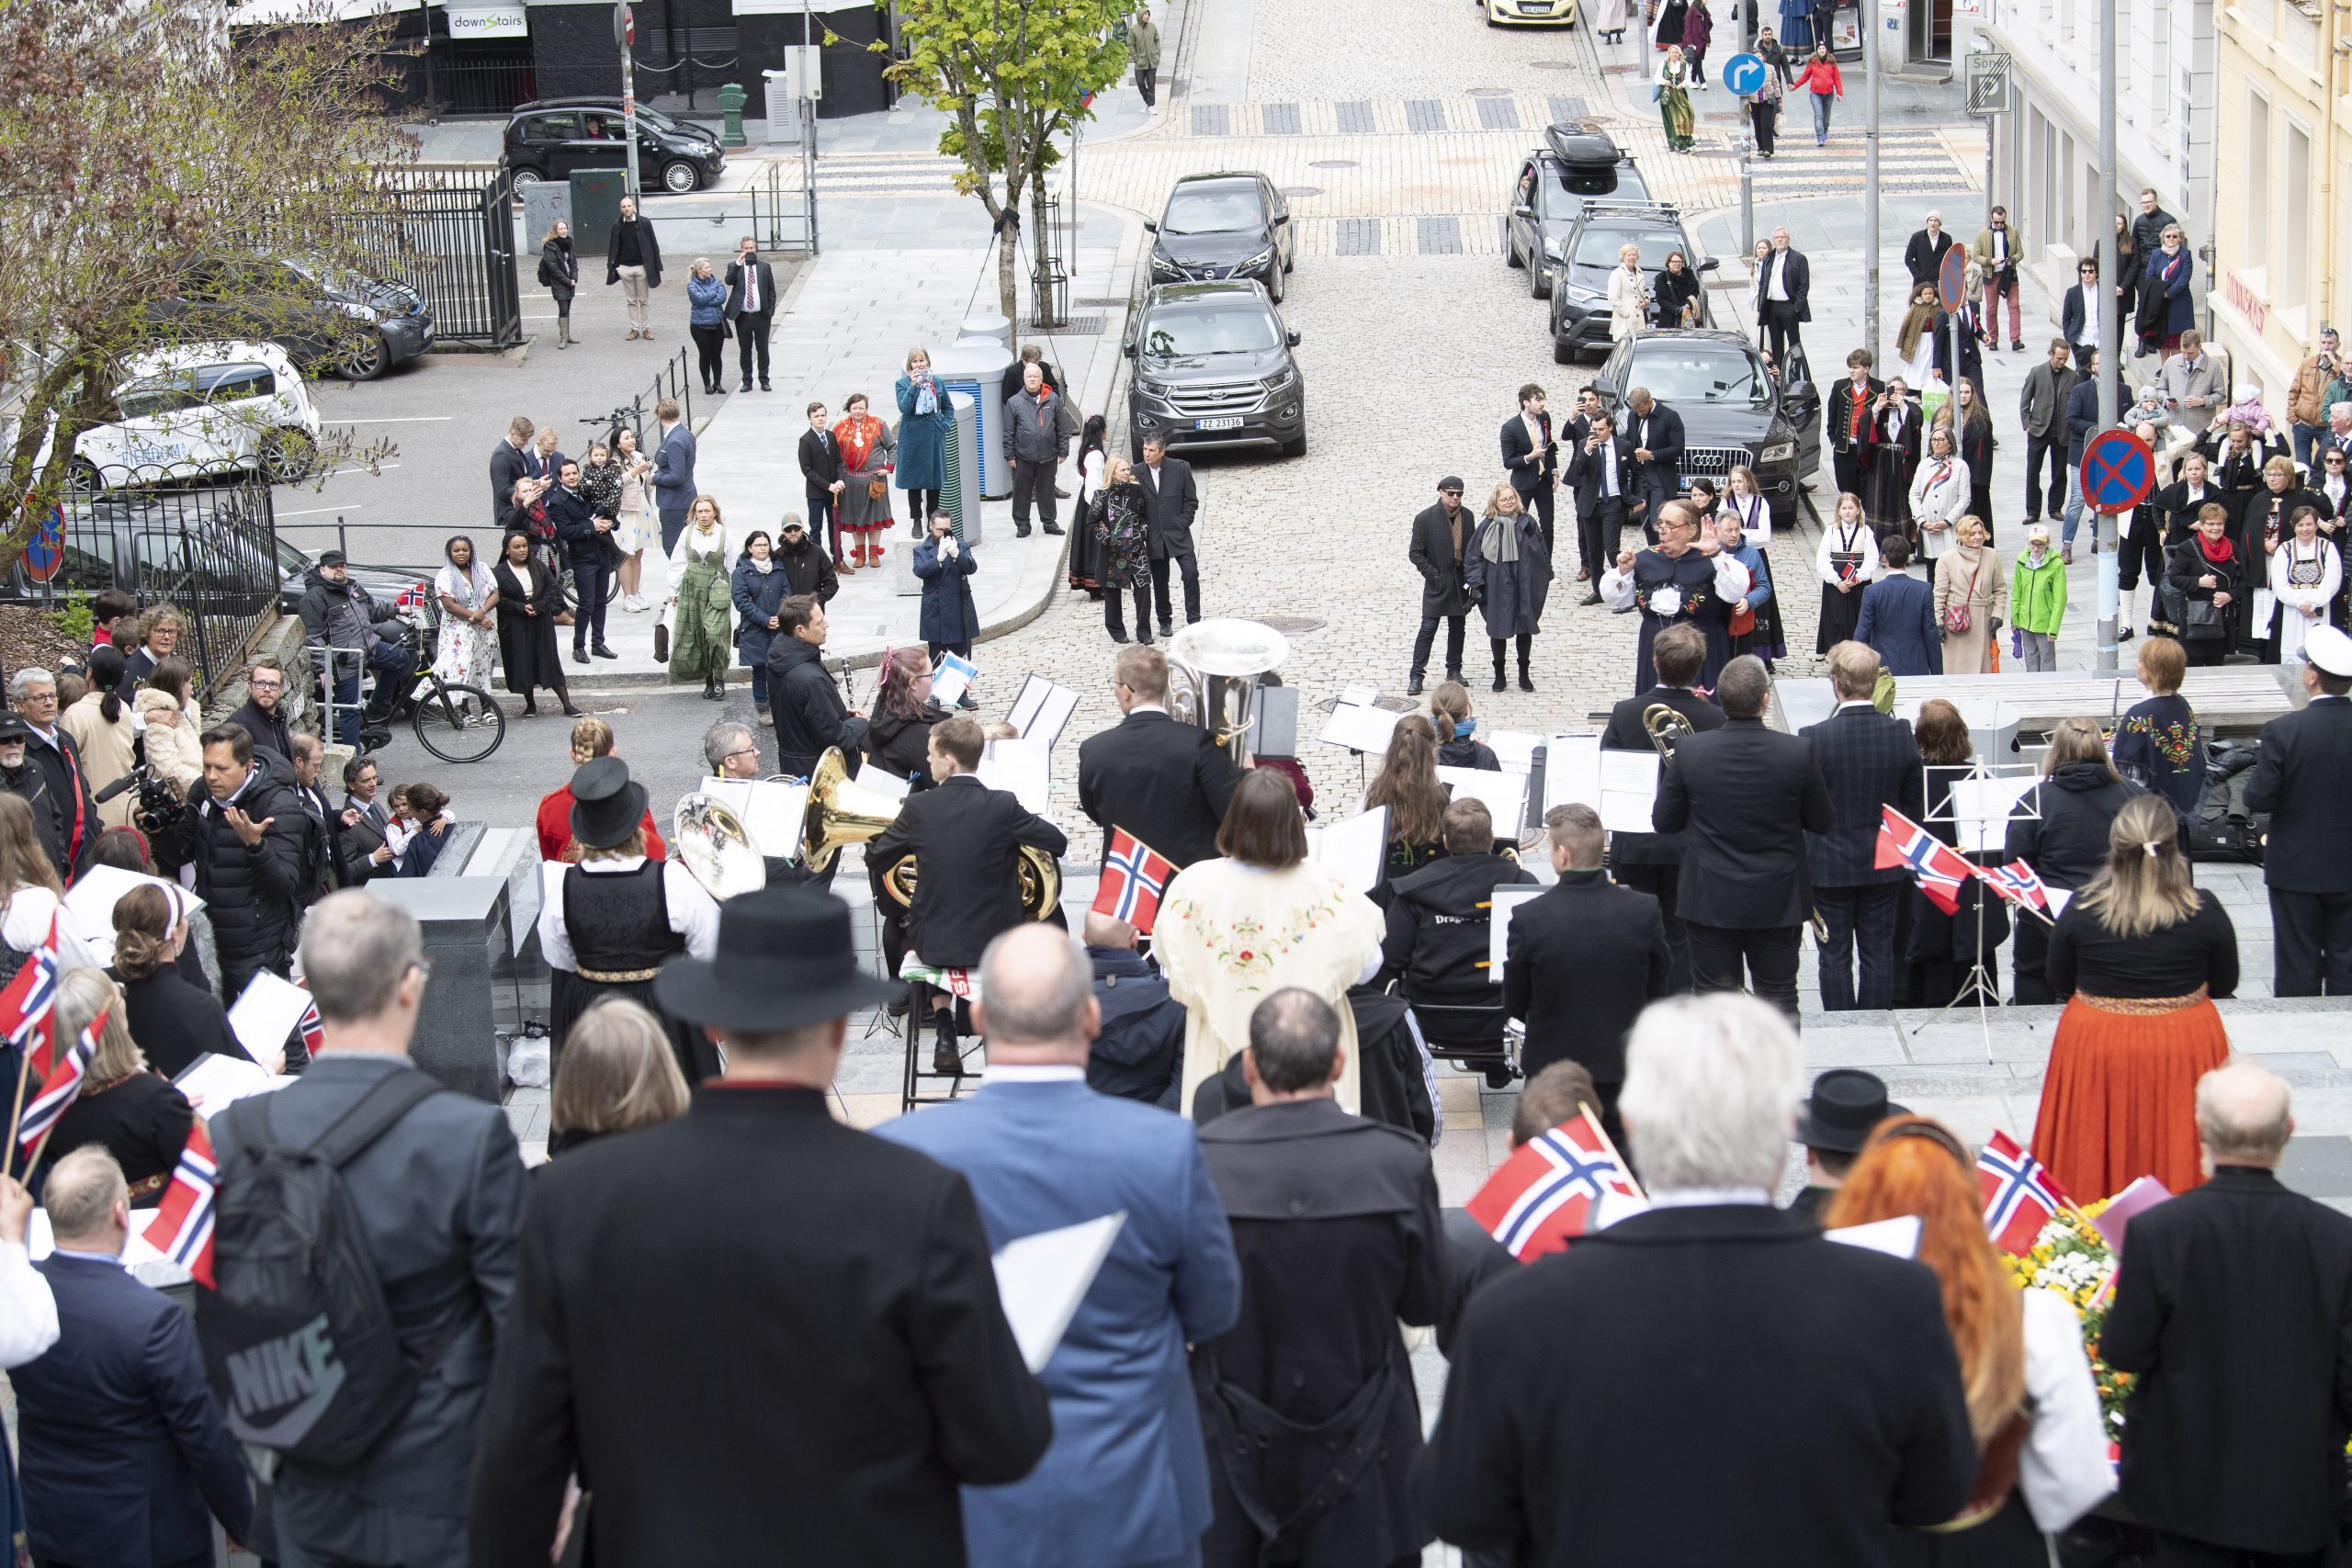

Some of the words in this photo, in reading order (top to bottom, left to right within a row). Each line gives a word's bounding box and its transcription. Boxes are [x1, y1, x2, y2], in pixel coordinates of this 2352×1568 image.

[1203, 420, 1213, 428] ZZ
[1216, 418, 1240, 427] 23136
[226, 1312, 339, 1416] NIKE
